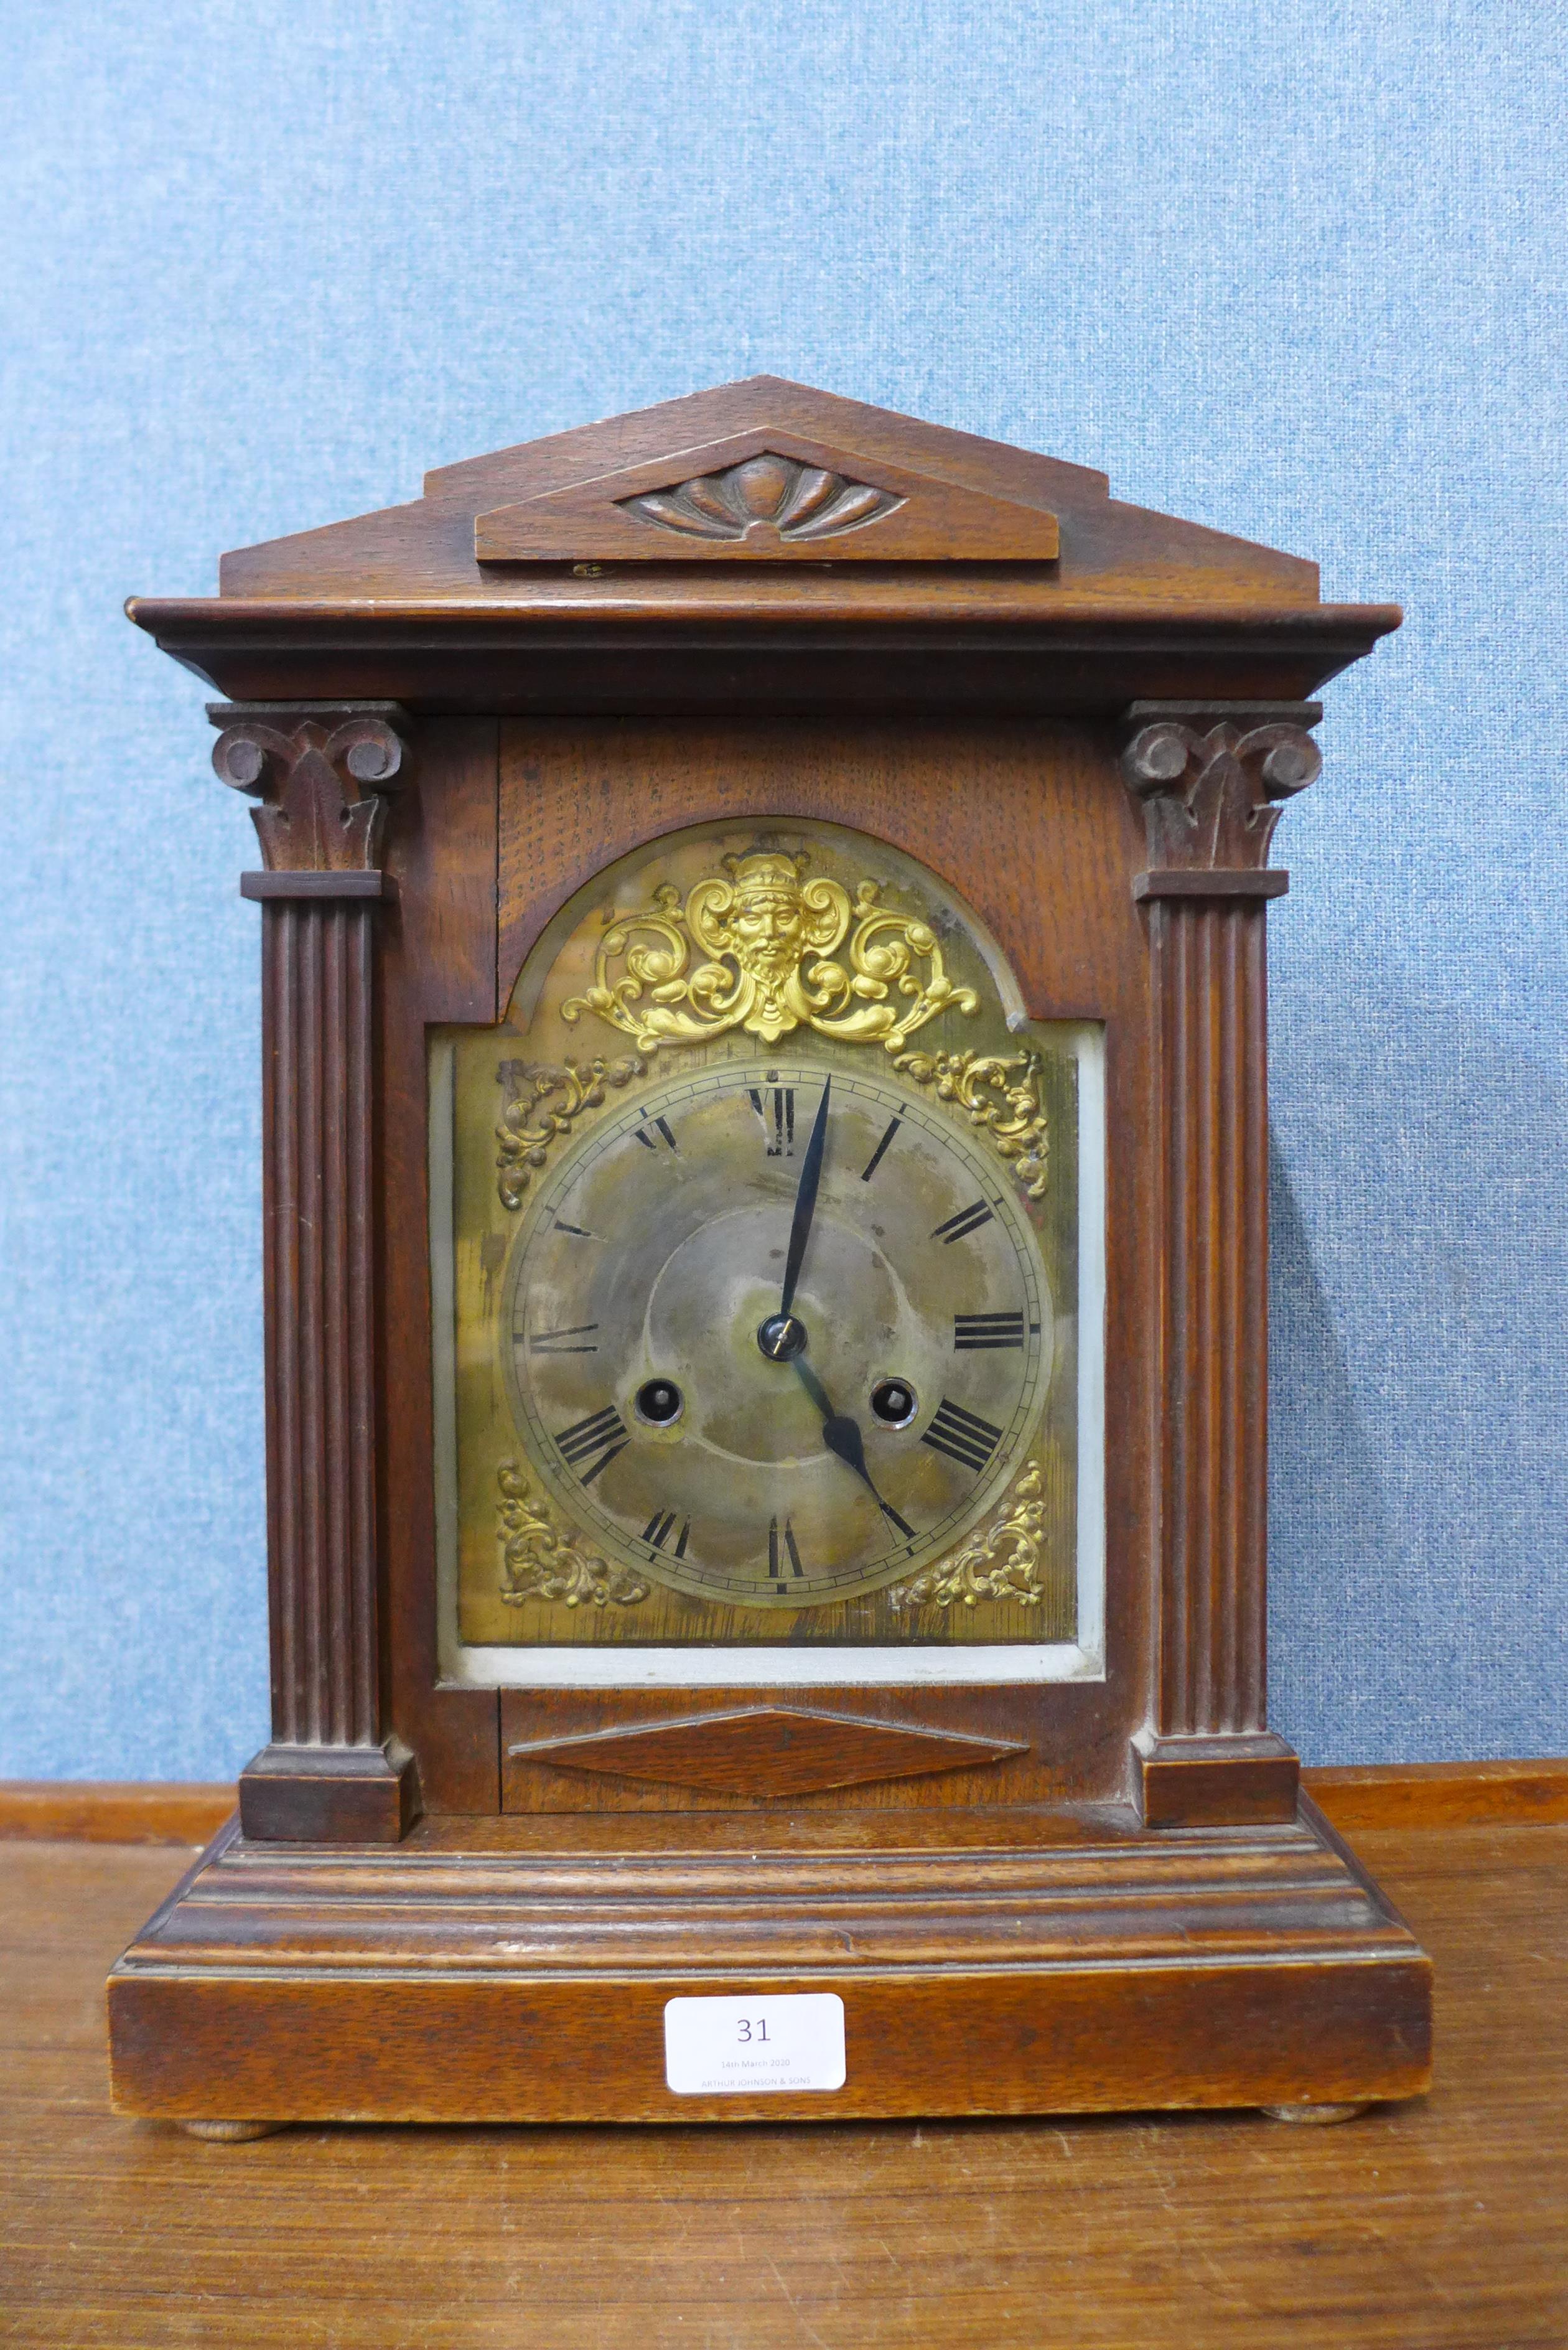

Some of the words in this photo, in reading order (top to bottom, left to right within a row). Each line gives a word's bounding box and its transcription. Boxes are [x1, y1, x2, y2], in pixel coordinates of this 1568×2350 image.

[954, 1305, 1024, 1353] III
[552, 1405, 633, 1490] VIII
[918, 1395, 1006, 1476] IIII
[737, 2018, 771, 2043] 31
[701, 2079, 735, 2088] ARTHUR
[737, 2077, 777, 2086] JOHNSON
[788, 2076, 811, 2085] SONS
[721, 2061, 740, 2069] 14th
[742, 2060, 768, 2068] March
[770, 2059, 790, 2067] 2020
